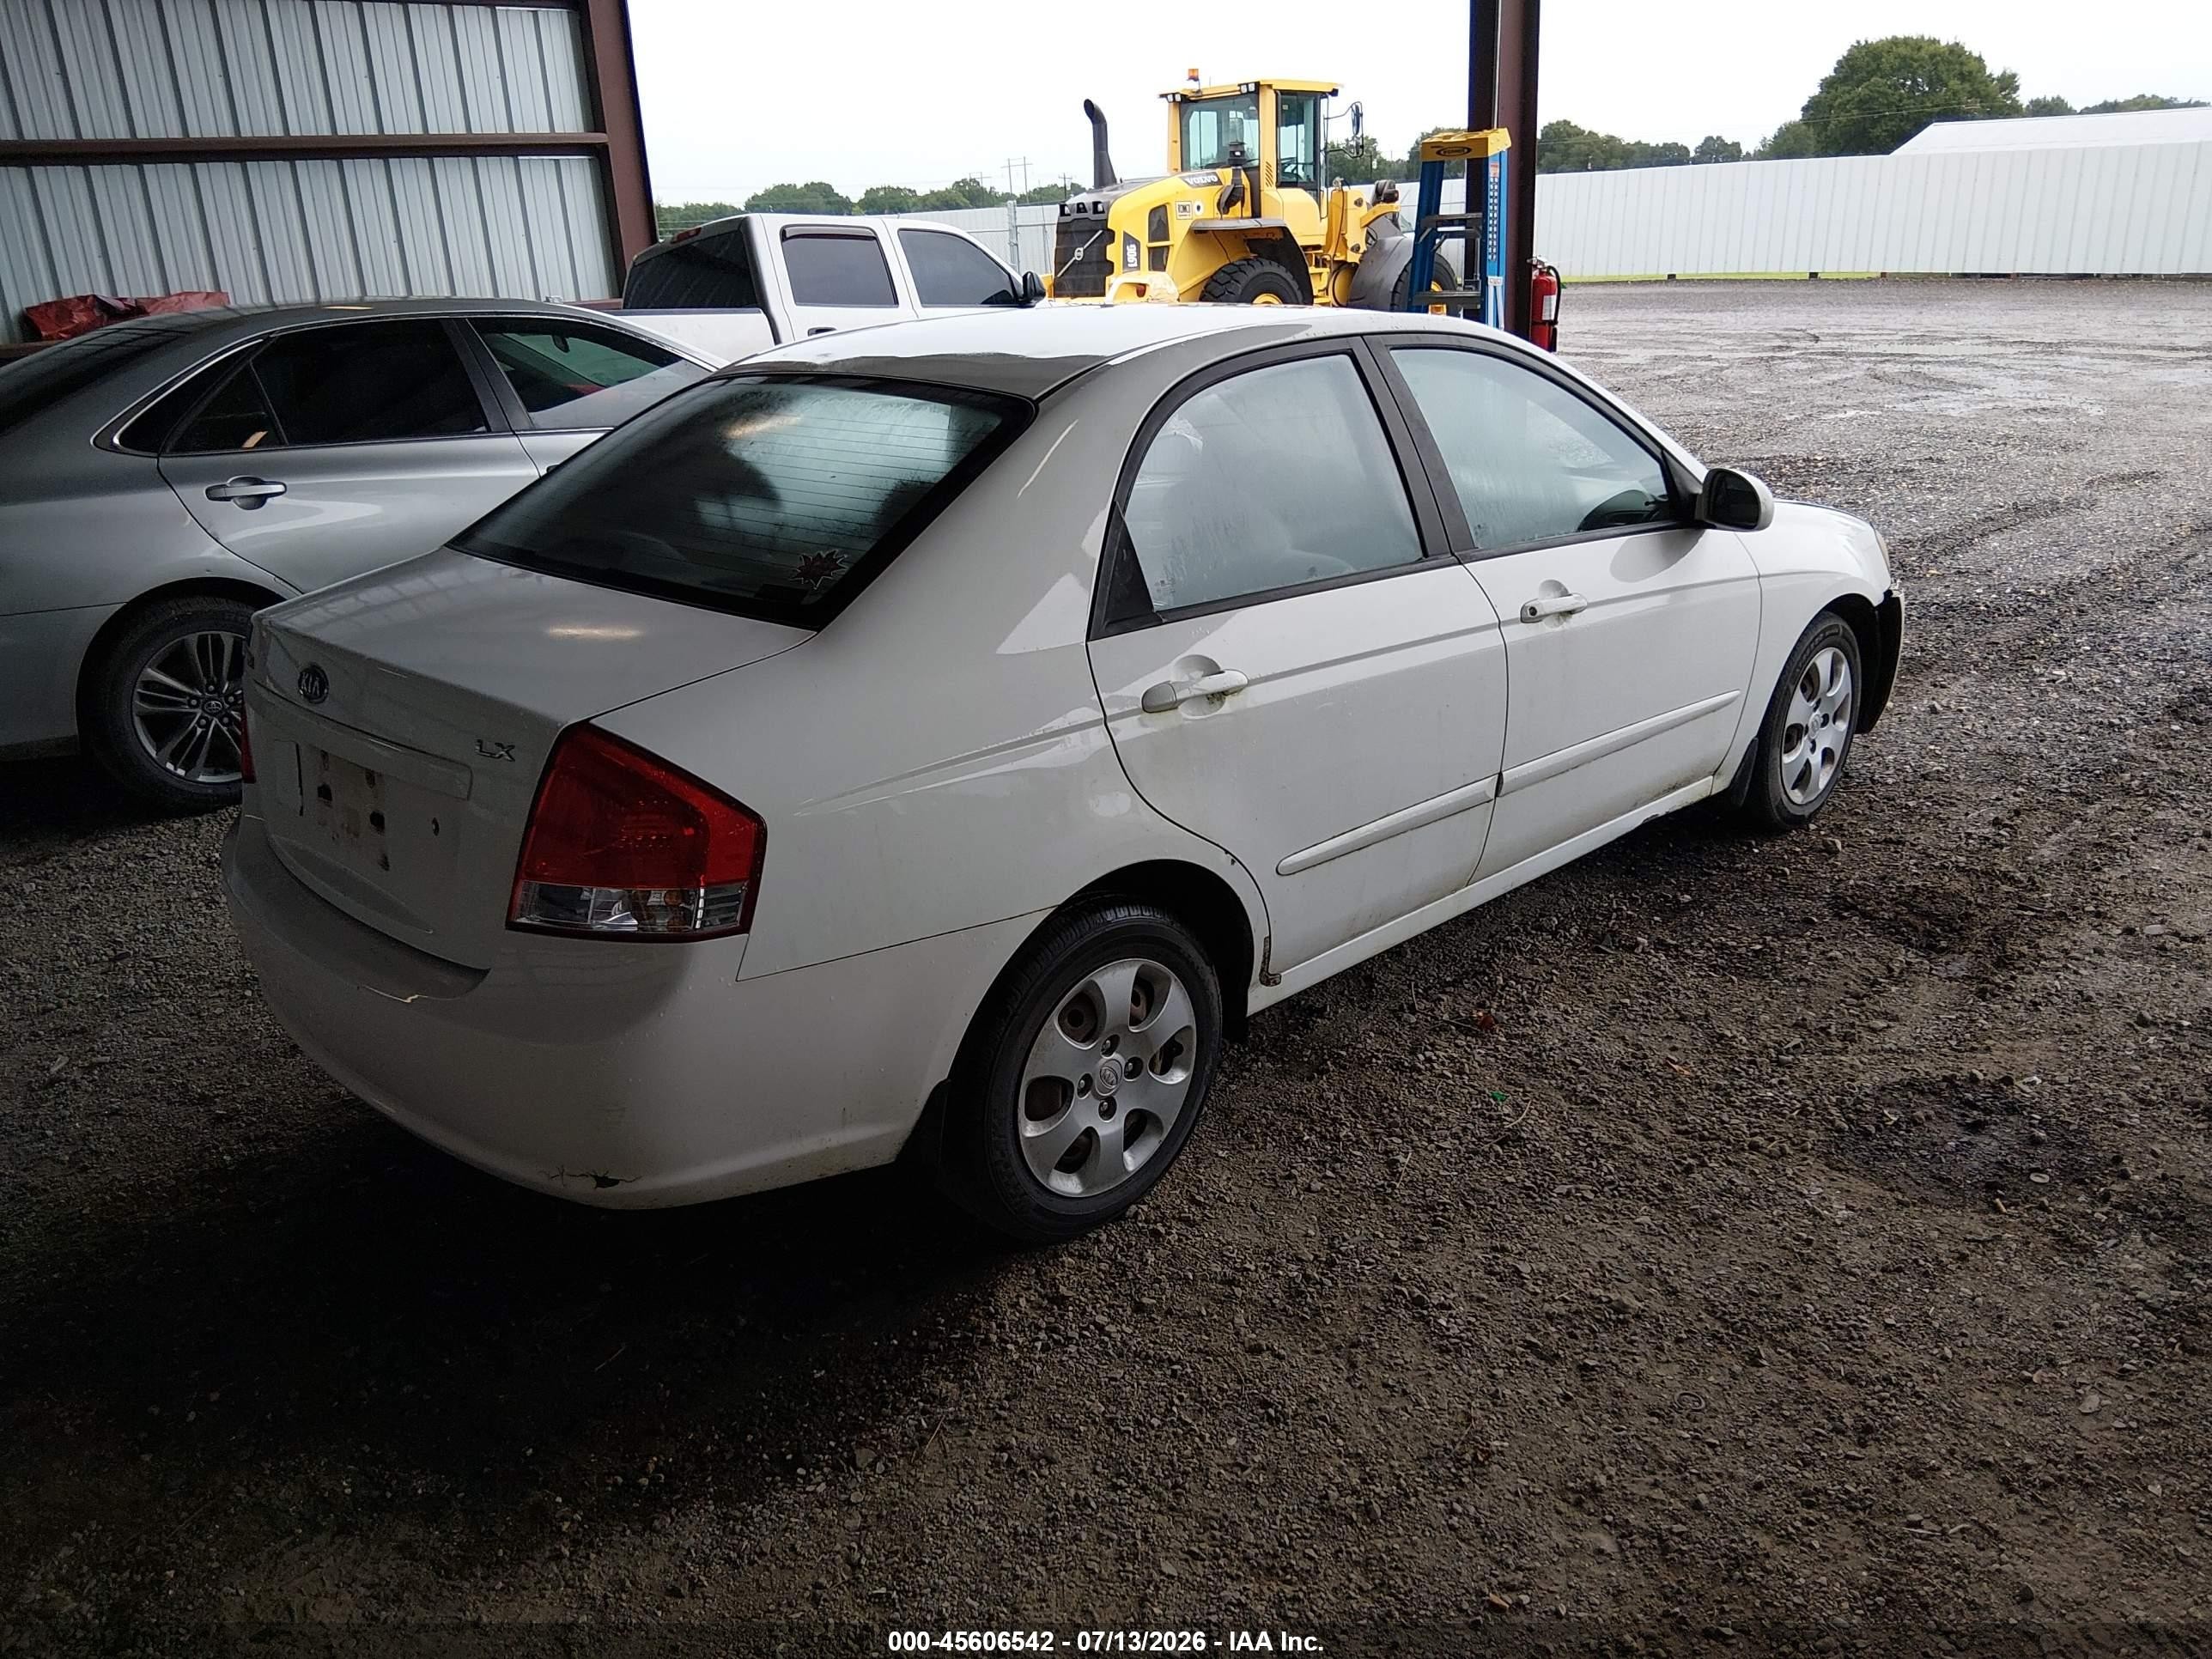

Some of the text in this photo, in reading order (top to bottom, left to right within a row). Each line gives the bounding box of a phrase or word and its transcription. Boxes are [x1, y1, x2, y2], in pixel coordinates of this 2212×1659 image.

[1184, 175, 1218, 185] VOLVO
[301, 672, 320, 696] KIA
[475, 738, 516, 763] LX
